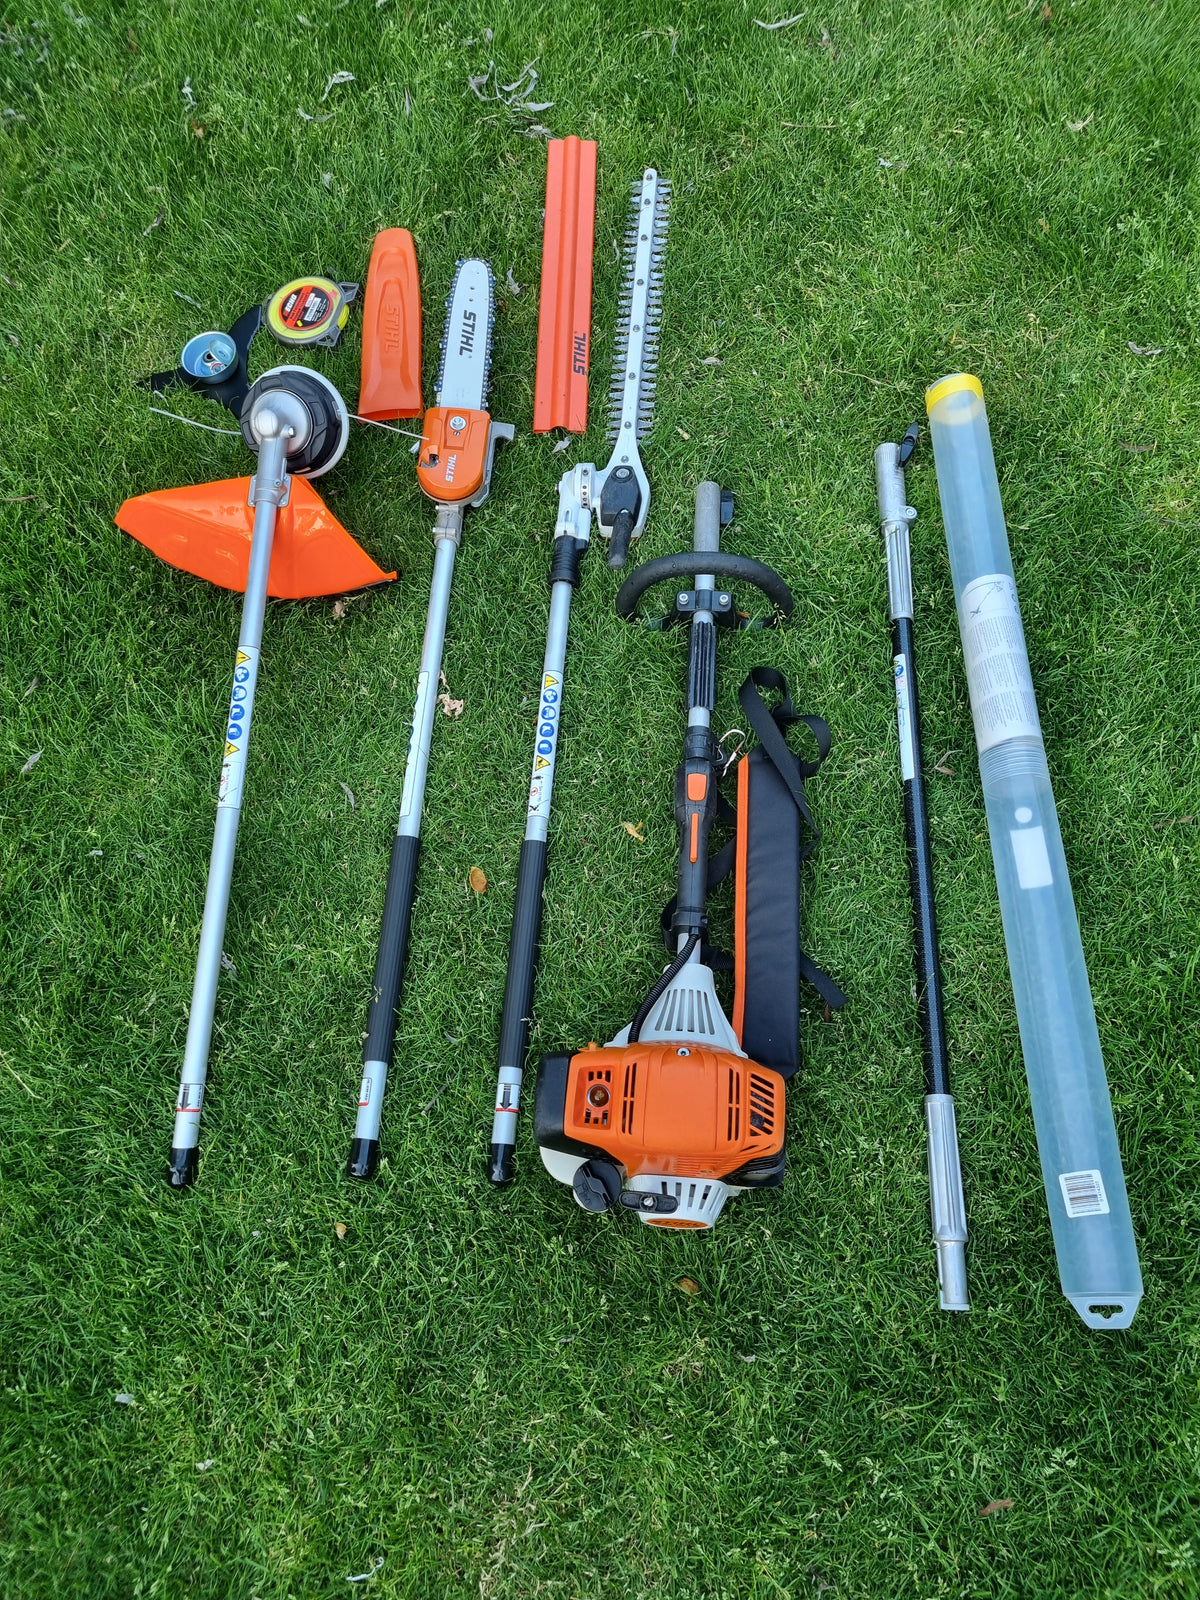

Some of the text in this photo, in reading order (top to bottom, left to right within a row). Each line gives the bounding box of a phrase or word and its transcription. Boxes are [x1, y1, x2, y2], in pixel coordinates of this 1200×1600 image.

[284, 293, 298, 313] ECHO
[385, 303, 401, 354] STIHL
[459, 309, 477, 357] STIHL
[573, 331, 587, 375] STIHL
[445, 453, 457, 483] STIHL
